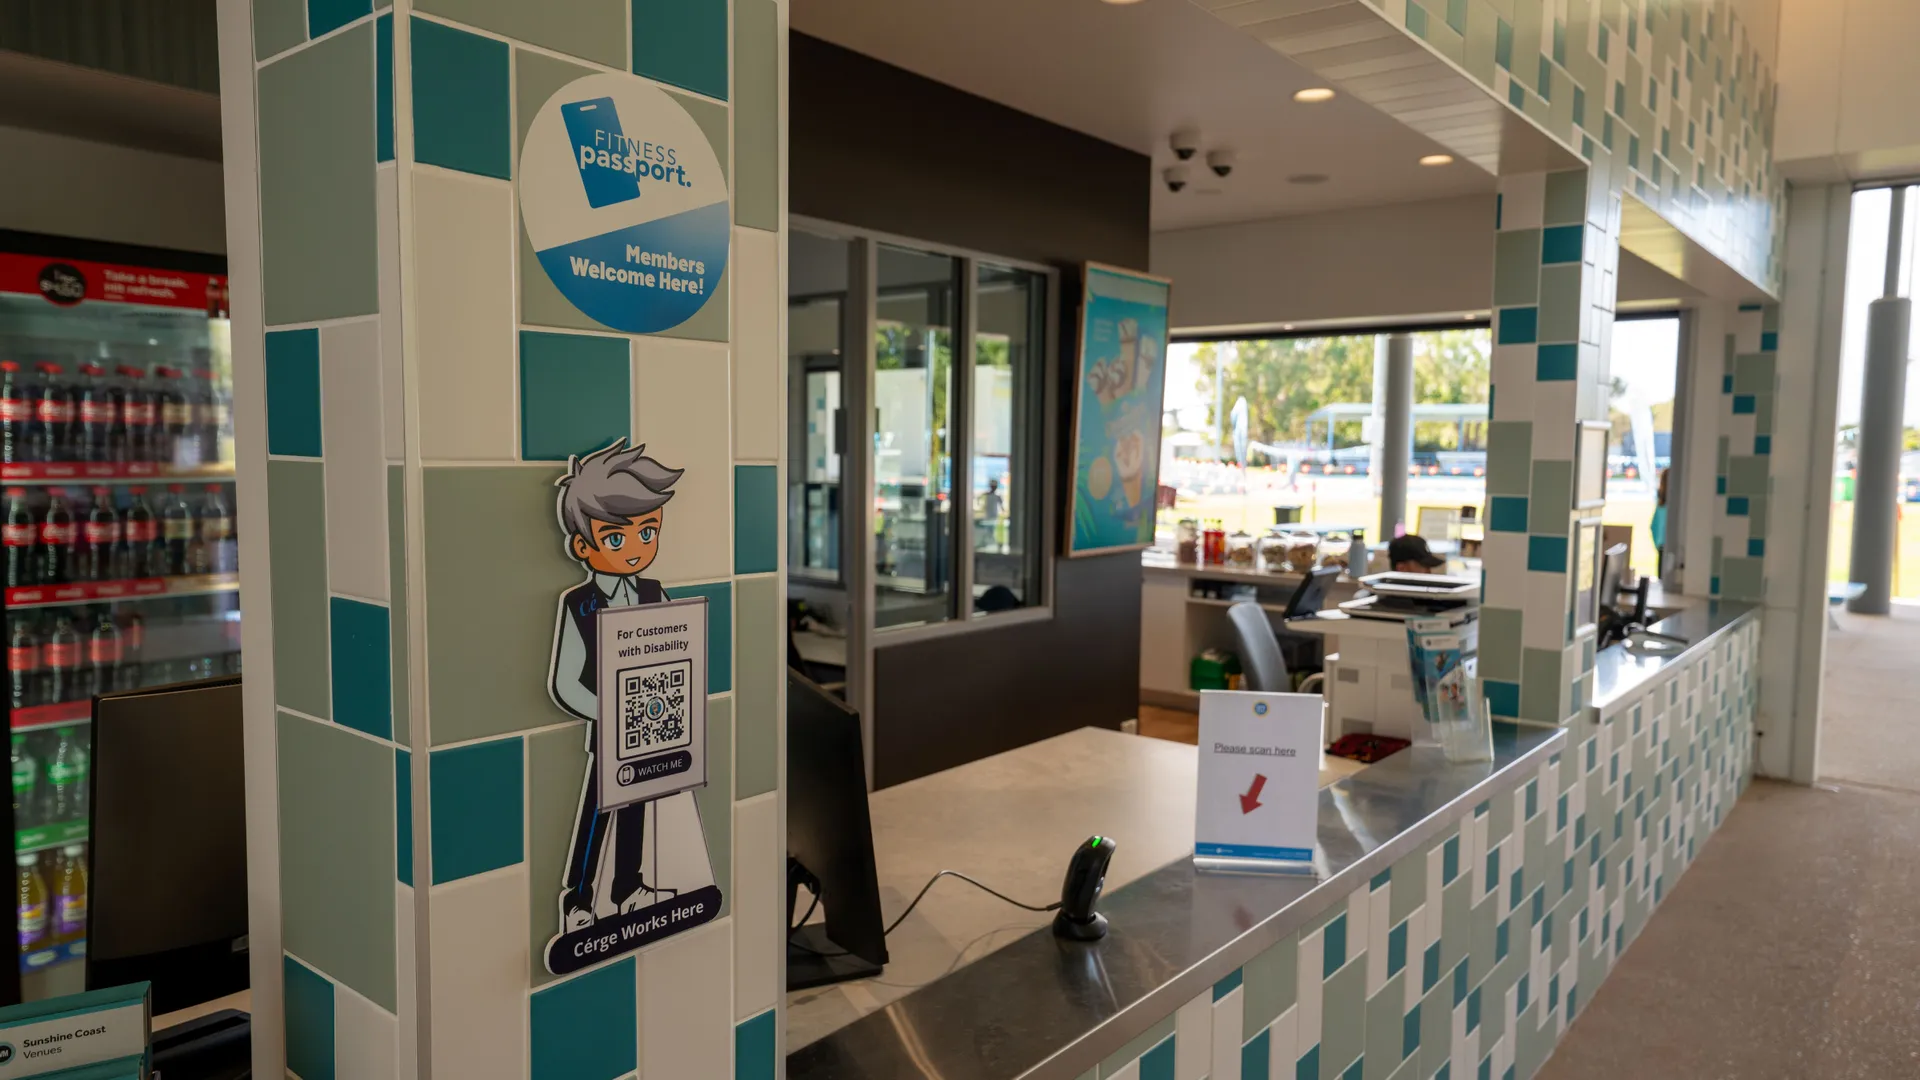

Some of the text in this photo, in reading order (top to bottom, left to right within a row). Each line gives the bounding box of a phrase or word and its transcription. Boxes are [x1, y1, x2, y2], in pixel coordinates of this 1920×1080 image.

[595, 129, 677, 166] FITNESS
[580, 144, 692, 188] passport.
[626, 243, 705, 275] Members
[569, 255, 704, 295] Welcome Here!
[617, 622, 688, 640] For Customers
[618, 639, 689, 658] with Disability
[1213, 742, 1297, 757] Please scan here
[637, 758, 683, 776] WATCH ME
[573, 901, 704, 958] Cérge Works Here
[23, 1025, 107, 1048] Sunshine Coast
[23, 1046, 63, 1060] Venues
